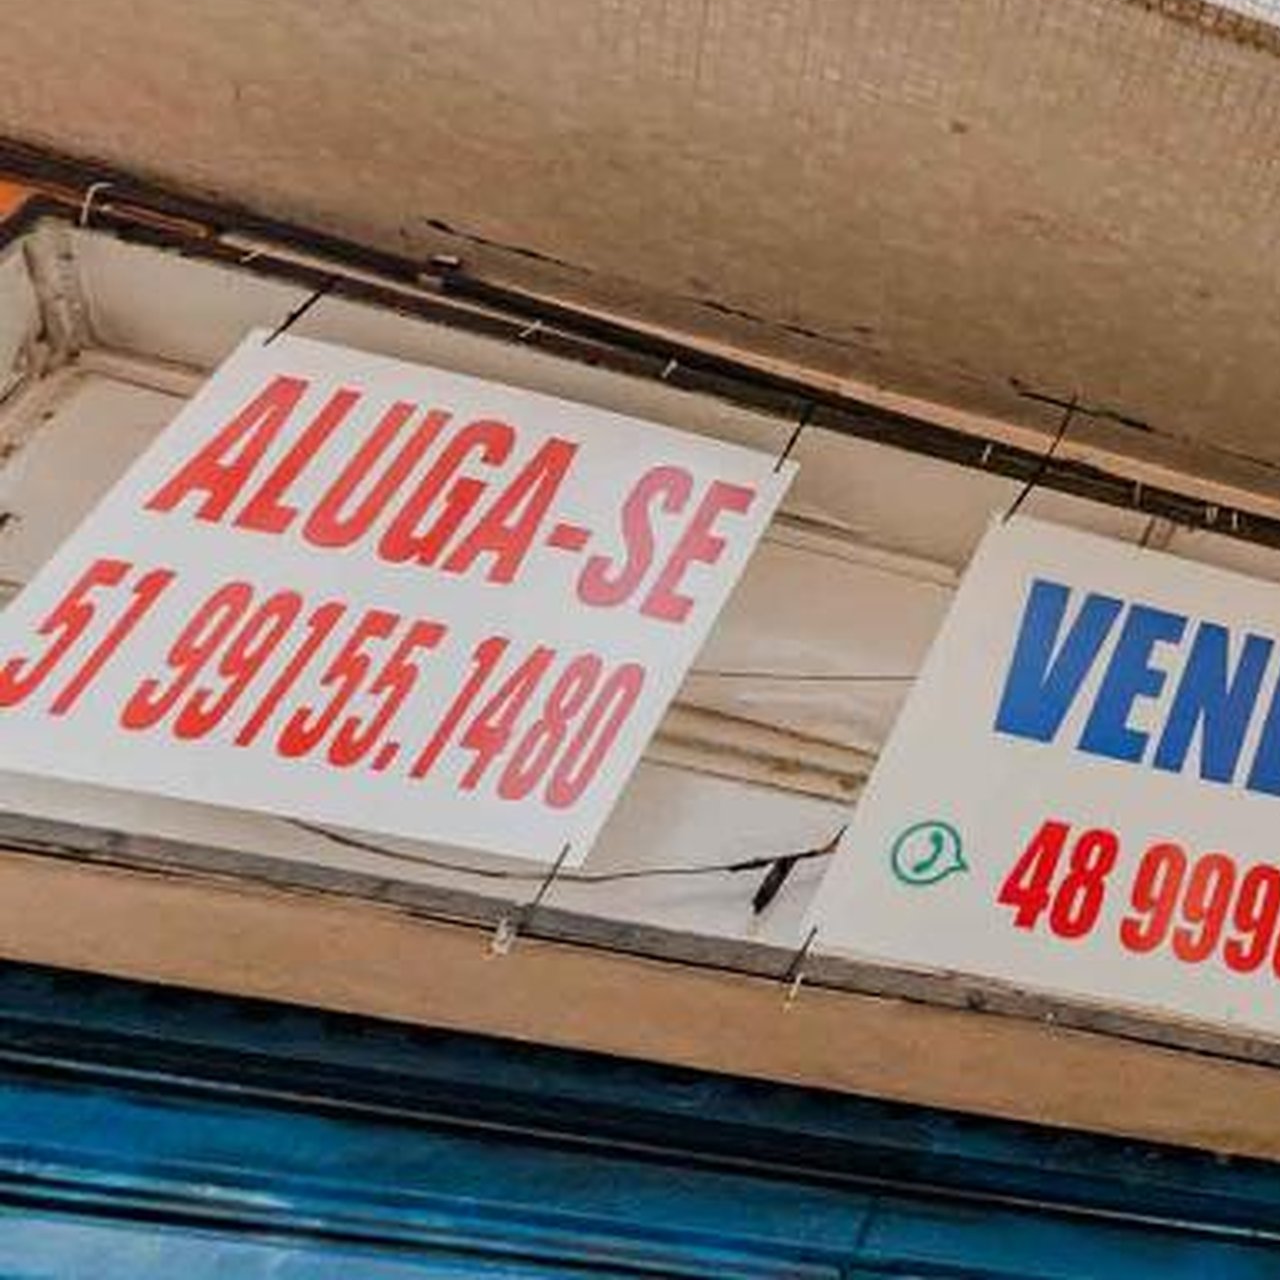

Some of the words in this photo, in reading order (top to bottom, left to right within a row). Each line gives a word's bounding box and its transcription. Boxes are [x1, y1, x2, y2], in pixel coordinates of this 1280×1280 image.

[144, 374, 758, 626] ALUGA-SE
[0, 556, 176, 716] 51
[120, 582, 648, 811] 99155.1480
[996, 817, 1122, 946] 48
